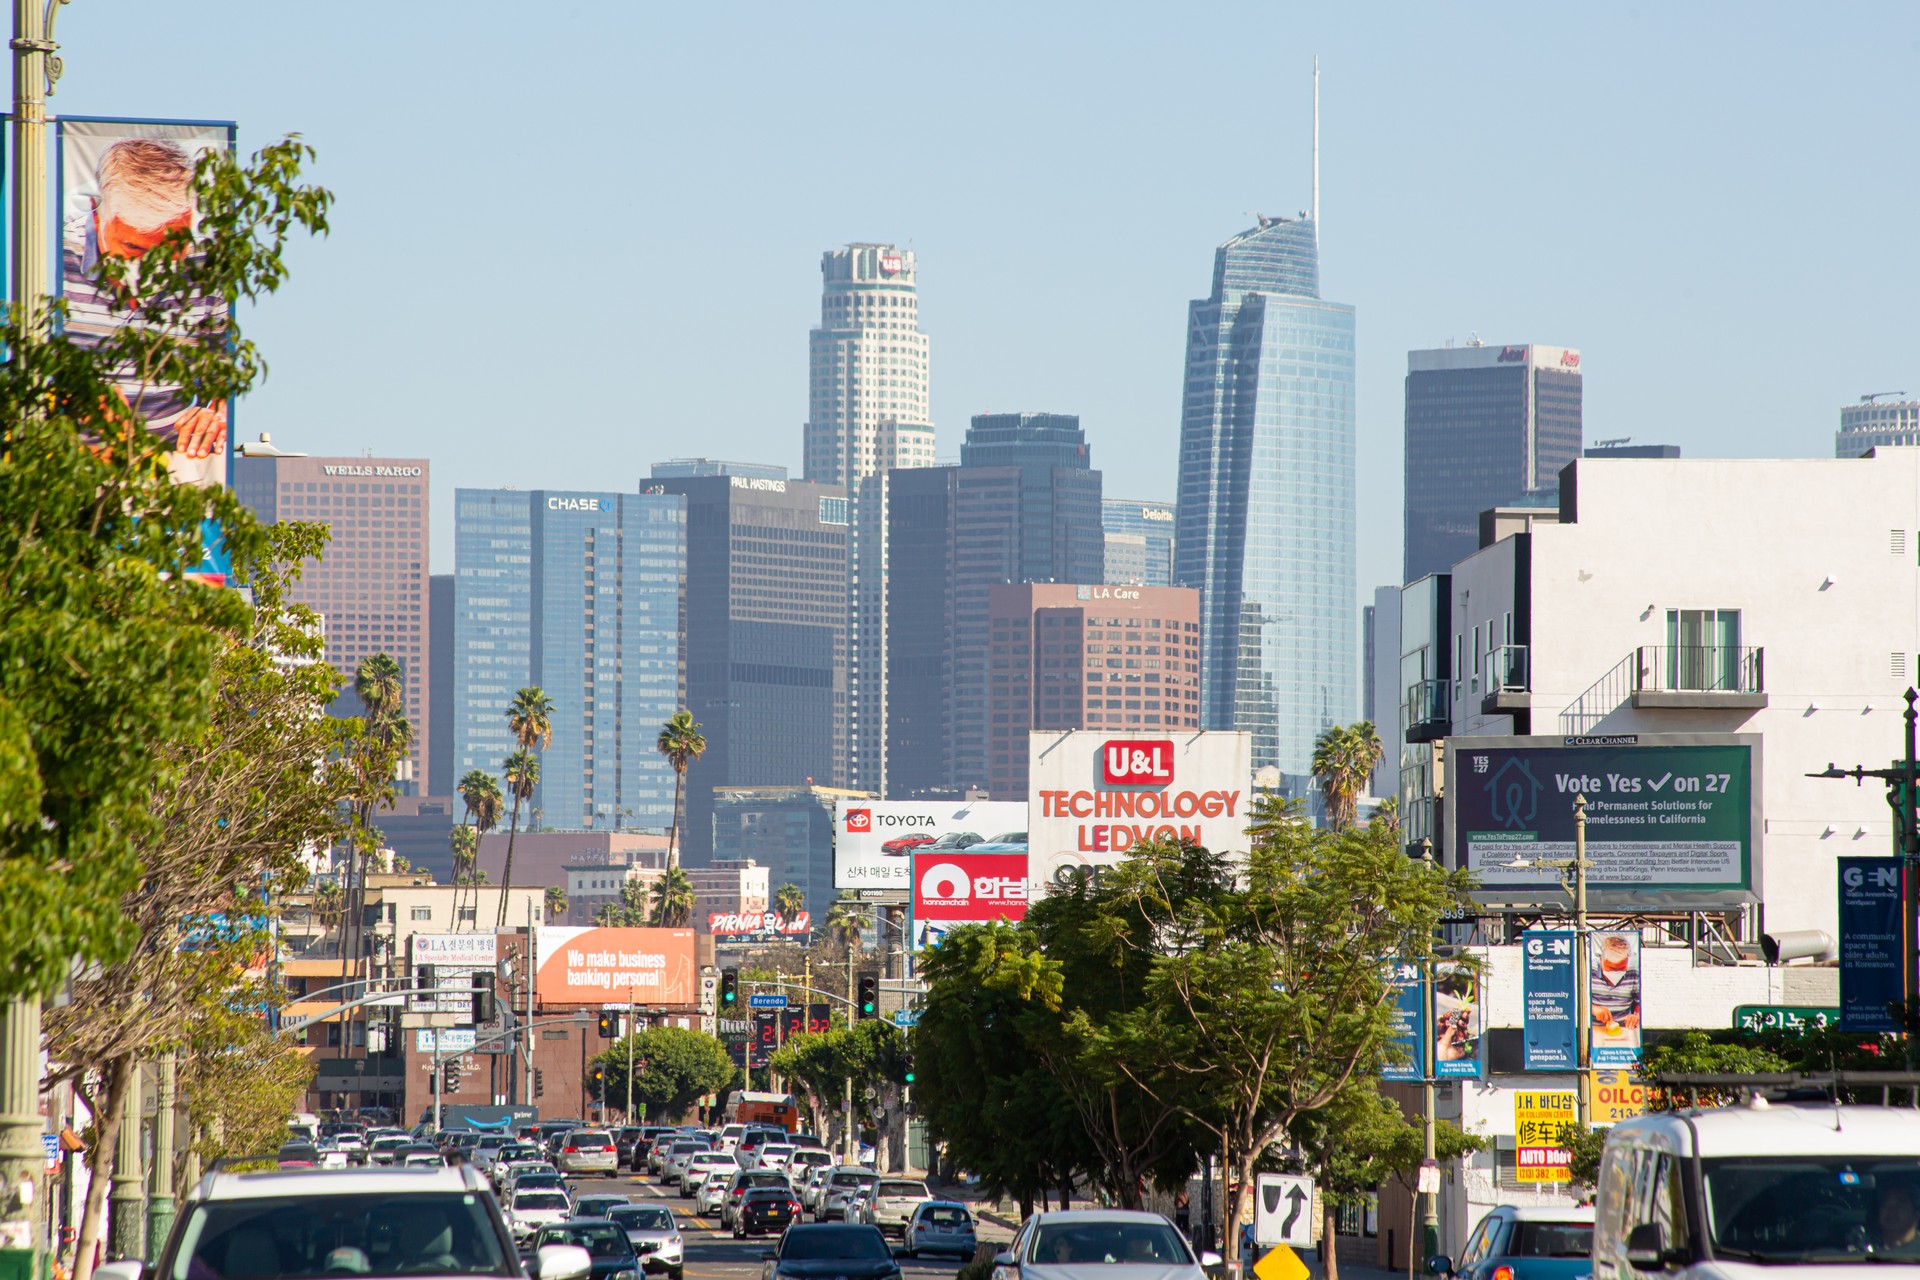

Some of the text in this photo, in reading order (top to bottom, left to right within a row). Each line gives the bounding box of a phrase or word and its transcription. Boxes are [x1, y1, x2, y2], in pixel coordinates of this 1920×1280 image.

[324, 465, 422, 478] WELLS FARGO
[731, 476, 786, 493] PAUL HASTINGS
[548, 498, 598, 511] CHASE
[1113, 589, 1140, 600] Care
[1108, 746, 1169, 778] U&L
[1473, 756, 1489, 765] YES
[1555, 774, 1731, 794] Vote Yes on 27
[1039, 789, 1241, 819] TECHNOLOGY
[1572, 800, 1713, 811] Fnd Permanent Solutions for
[876, 815, 936, 827] TOYOTA
[1584, 814, 1706, 825] omelessness in California
[847, 866, 868, 878] 신차
[870, 866, 890, 878] 매일
[922, 898, 970, 907] hannamchain
[1851, 933, 1896, 942] community
[431, 940, 447, 952] LA
[1845, 942, 1867, 951] space
[567, 950, 666, 969] We make business
[1865, 951, 1889, 959] adults
[567, 968, 660, 990] banking personal
[753, 997, 784, 1005] Berendo
[1517, 1095, 1536, 1109] J.H.
[513, 1111, 533, 1120] prime
[1526, 1111, 1553, 1119] COLLISION
[1553, 1111, 1573, 1119] CENTER
[1520, 1149, 1546, 1165] AUTO
